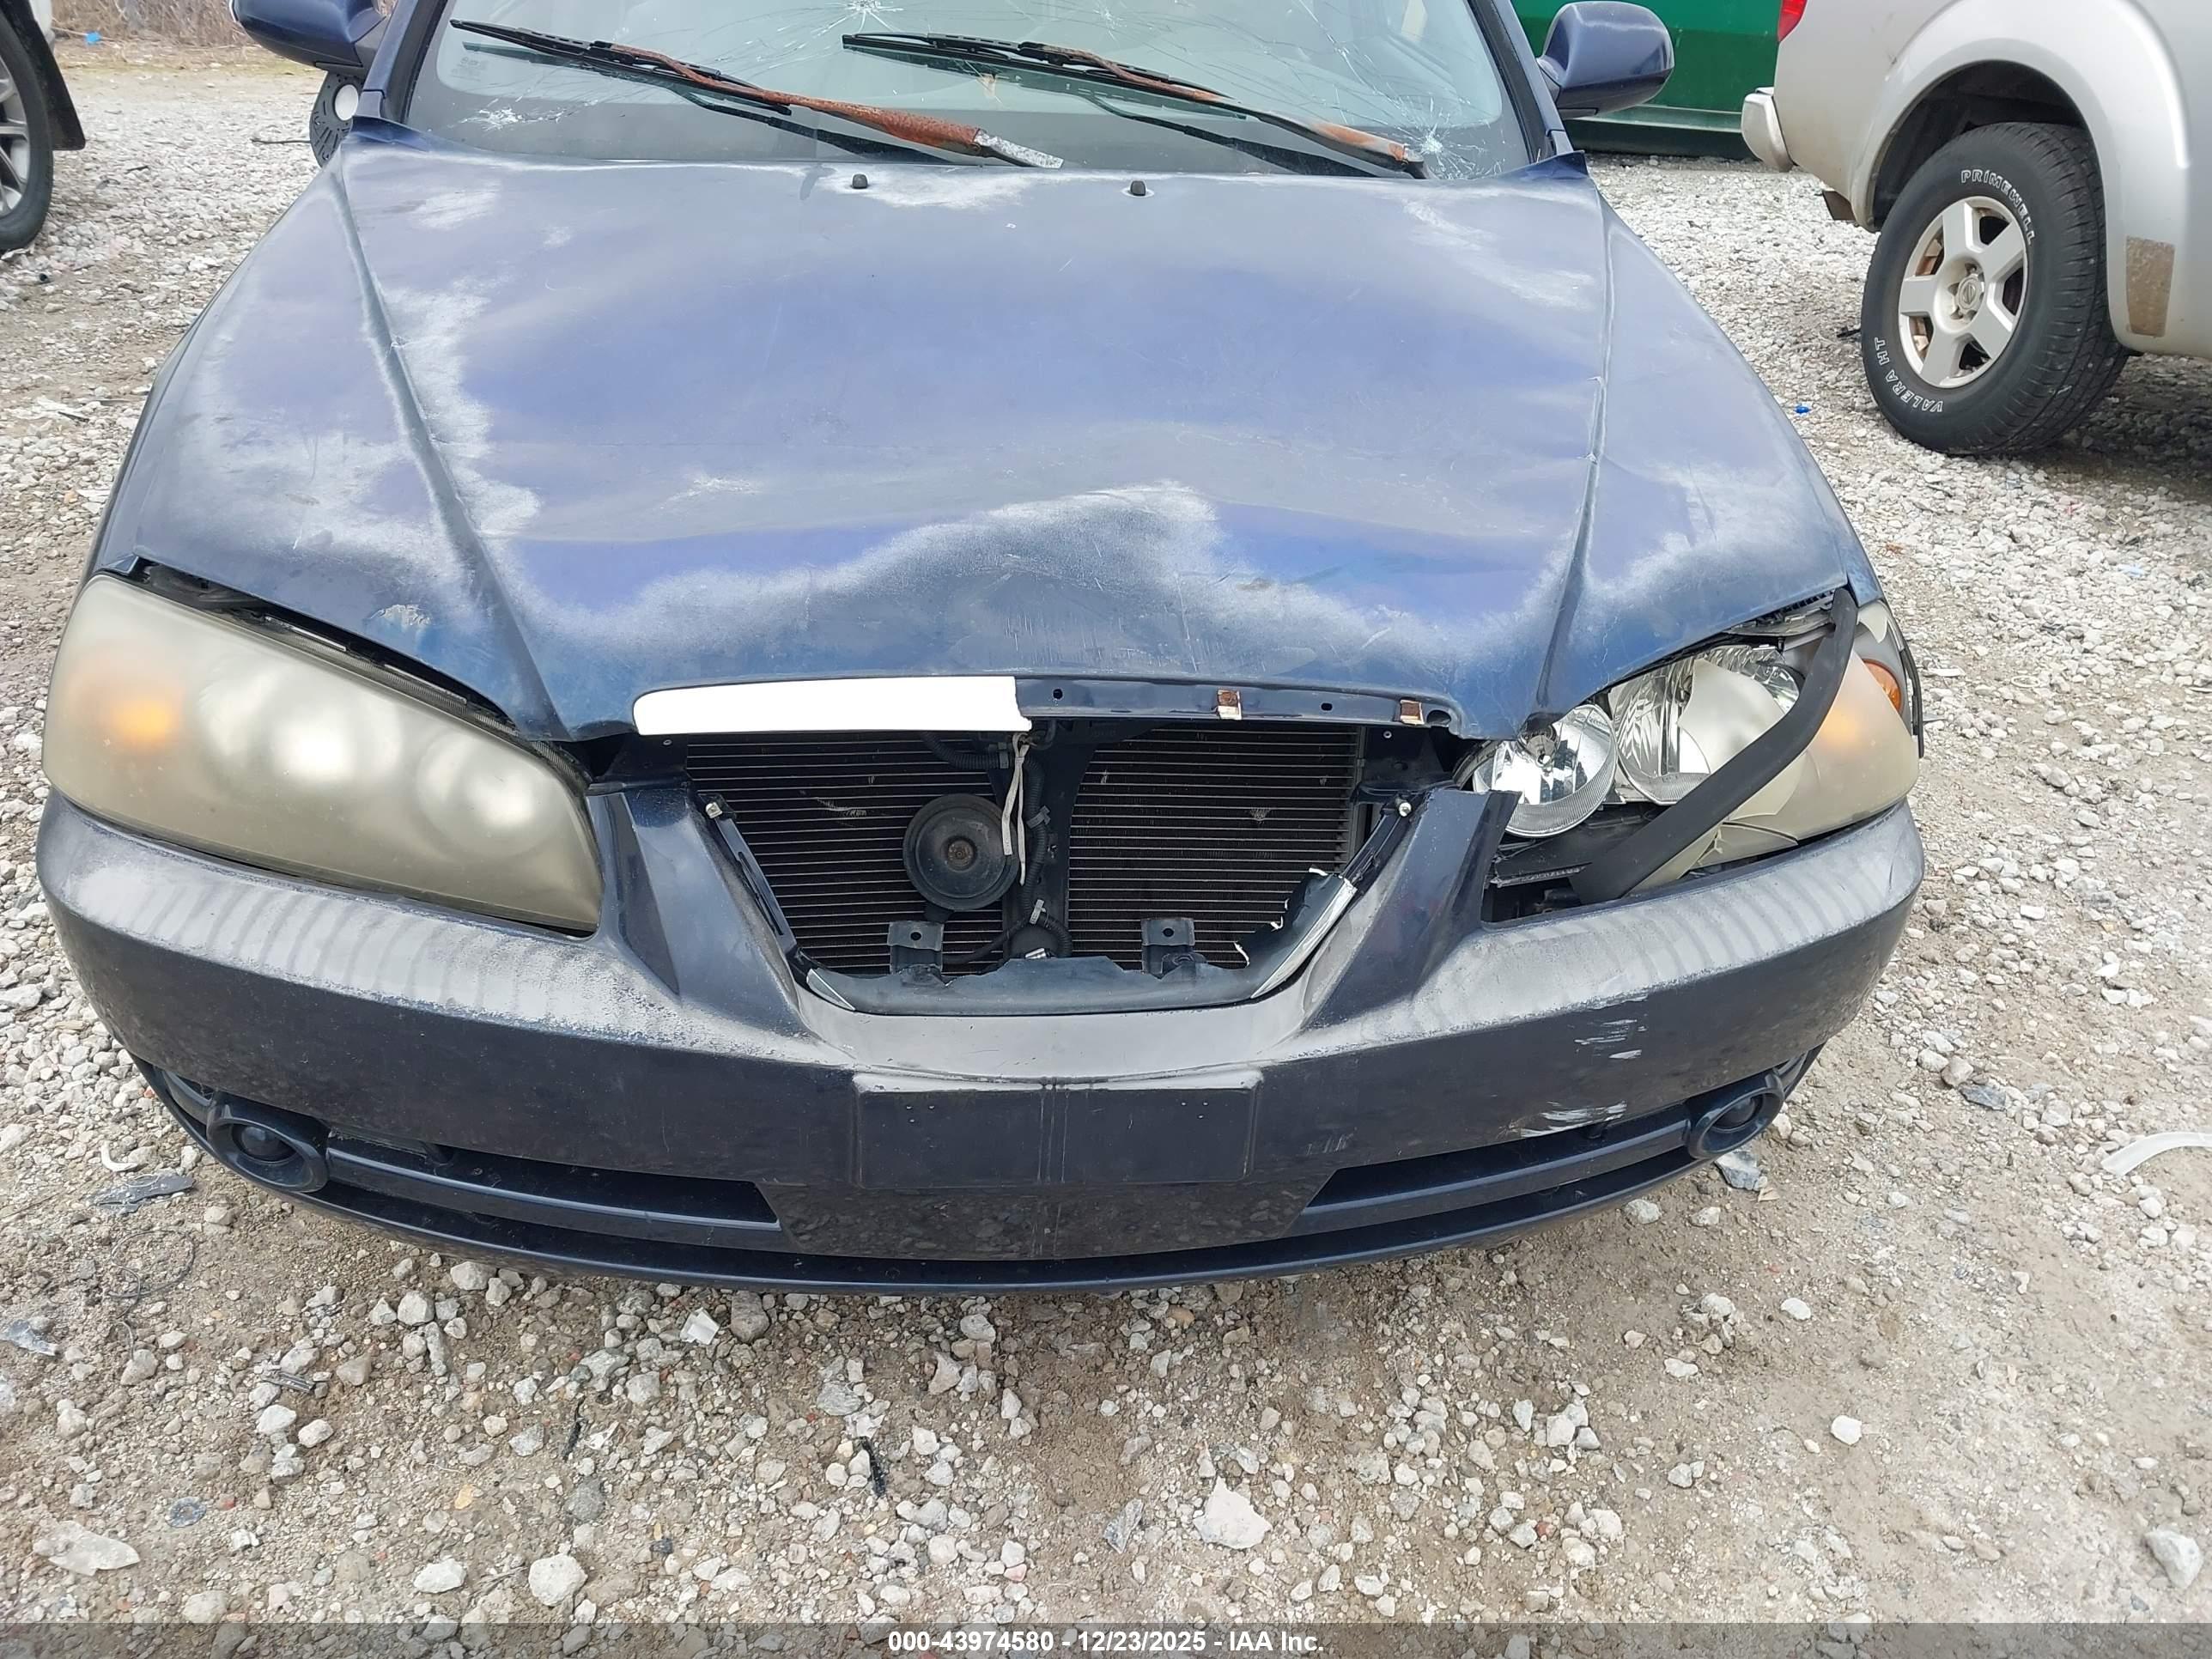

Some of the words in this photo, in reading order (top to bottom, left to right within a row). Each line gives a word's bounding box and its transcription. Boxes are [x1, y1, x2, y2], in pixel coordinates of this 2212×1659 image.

[1960, 168, 2035, 246] PRIMEWELL
[1874, 337, 1890, 366] HT
[1885, 369, 1943, 413] VALERA
